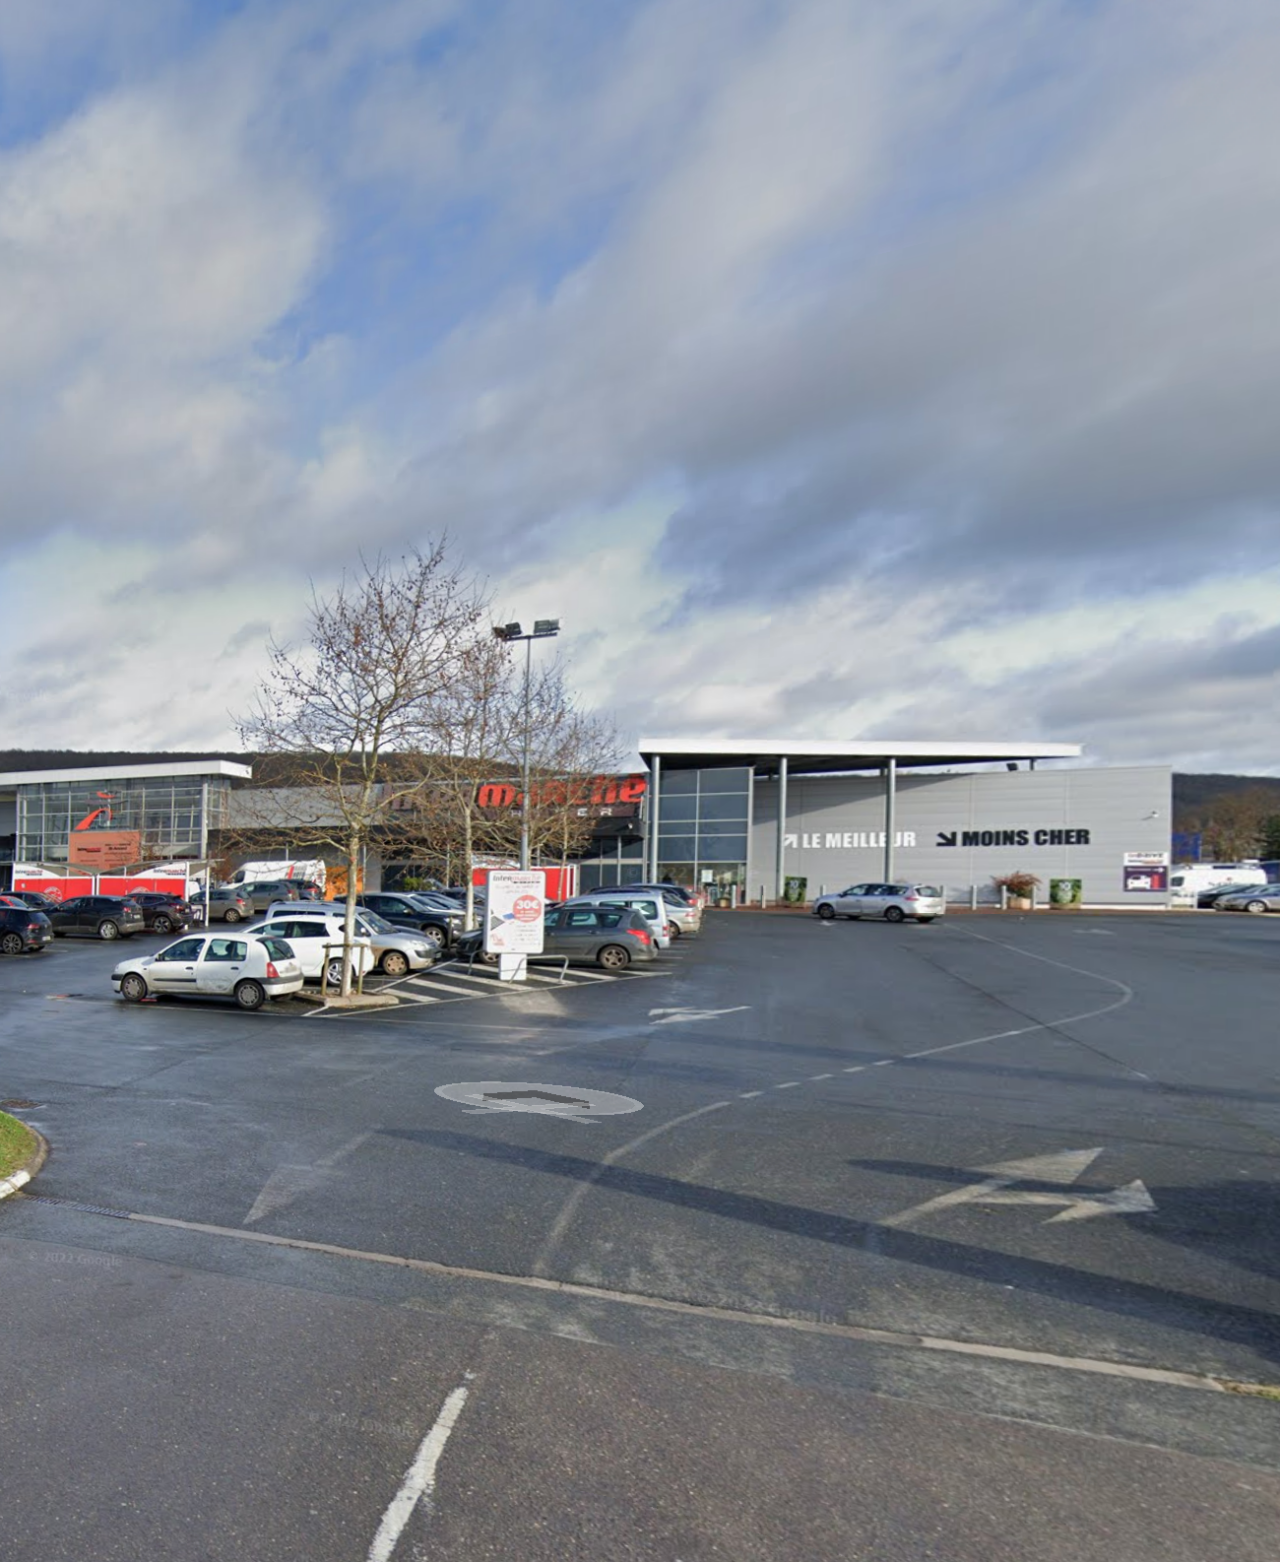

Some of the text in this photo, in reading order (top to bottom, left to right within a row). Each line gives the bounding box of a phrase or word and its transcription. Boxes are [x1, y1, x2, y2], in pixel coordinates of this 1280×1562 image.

[802, 833, 821, 848] LE
[961, 829, 1090, 847] MOINS CHER
[517, 900, 540, 909] 30€
